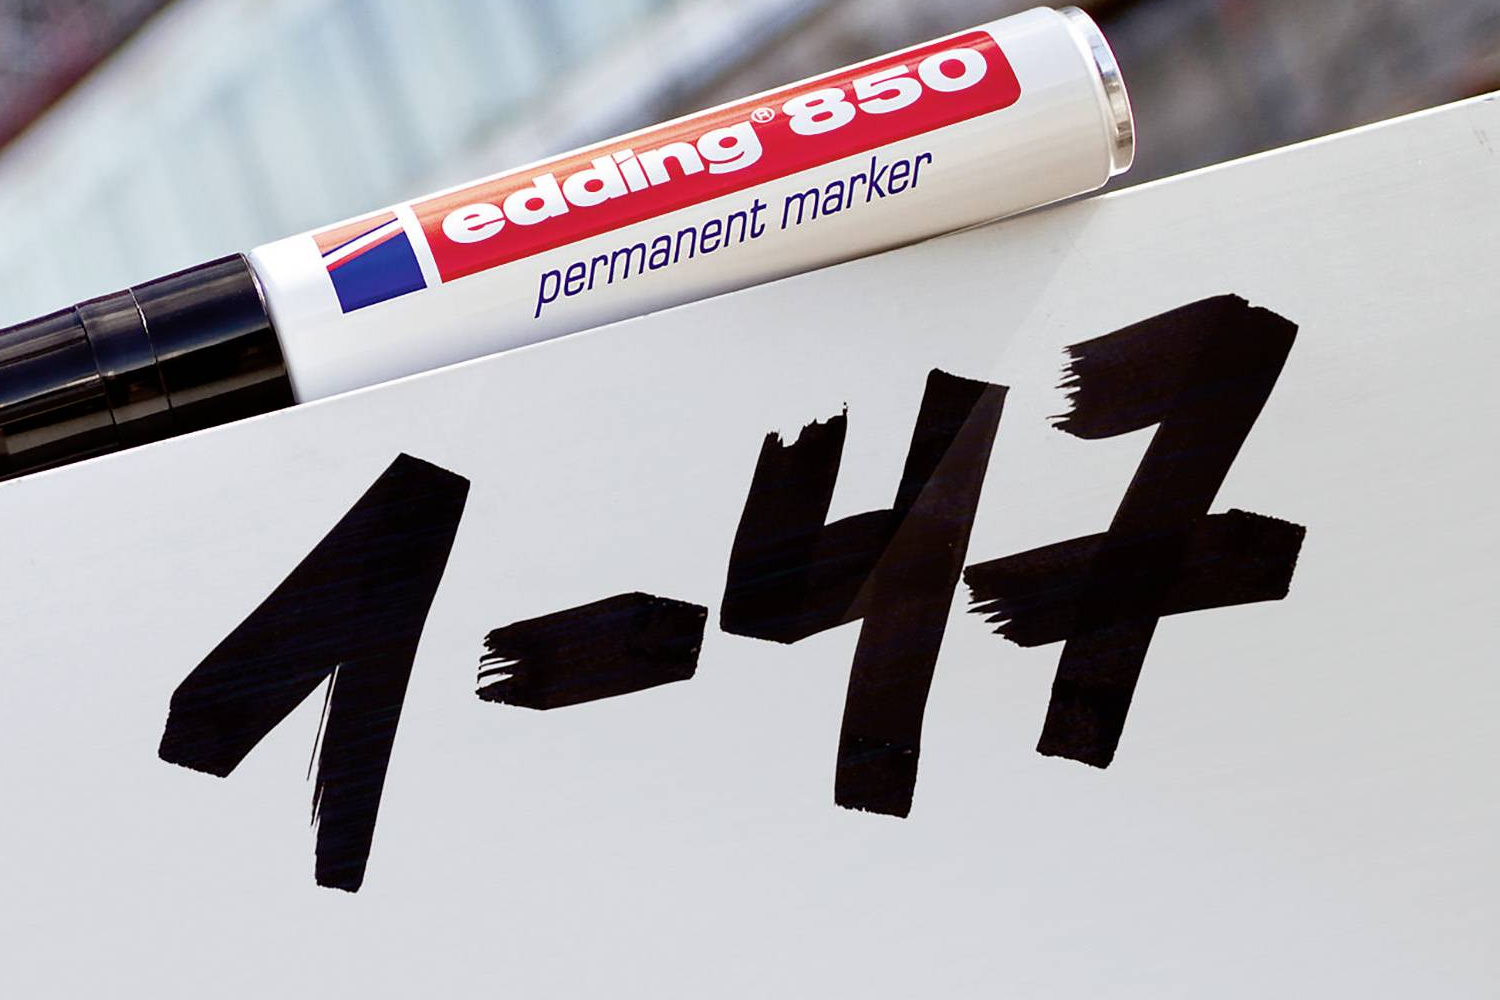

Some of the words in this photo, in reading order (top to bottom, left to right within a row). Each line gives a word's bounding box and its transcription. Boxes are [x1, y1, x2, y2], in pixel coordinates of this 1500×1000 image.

[781, 47, 988, 137] 850
[534, 198, 767, 319] permanent
[780, 151, 933, 231] marker
[157, 293, 1306, 894] 1-47
